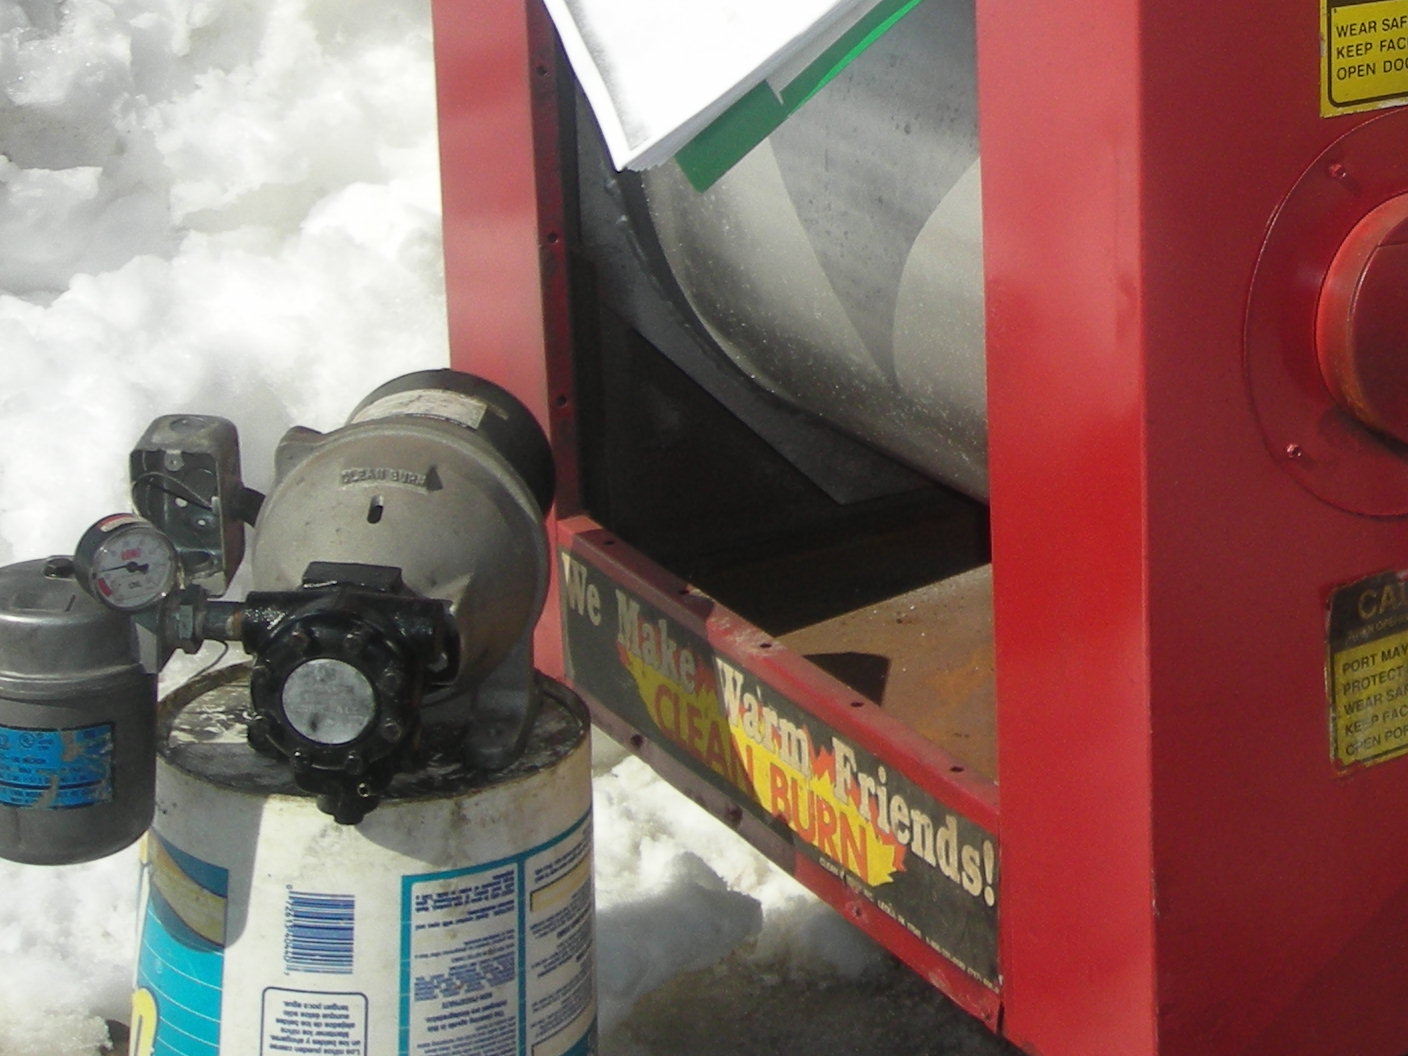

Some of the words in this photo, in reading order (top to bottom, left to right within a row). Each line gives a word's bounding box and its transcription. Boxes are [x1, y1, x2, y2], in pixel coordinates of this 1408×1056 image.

[1336, 20, 1377, 37] WEAR
[1336, 42, 1373, 59] KEEP
[1336, 62, 1376, 80] OPEN
[1342, 653, 1376, 675] PORT
[1343, 666, 1403, 696] PROTECT
[1344, 694, 1383, 717] WEAR
[561, 552, 602, 627] We
[615, 588, 697, 694] Make
[715, 656, 812, 780] Warm
[831, 737, 997, 908] Friends!
[1345, 736, 1381, 756] OPEN
[654, 683, 754, 797] CLEAN
[770, 762, 869, 883] BURN
